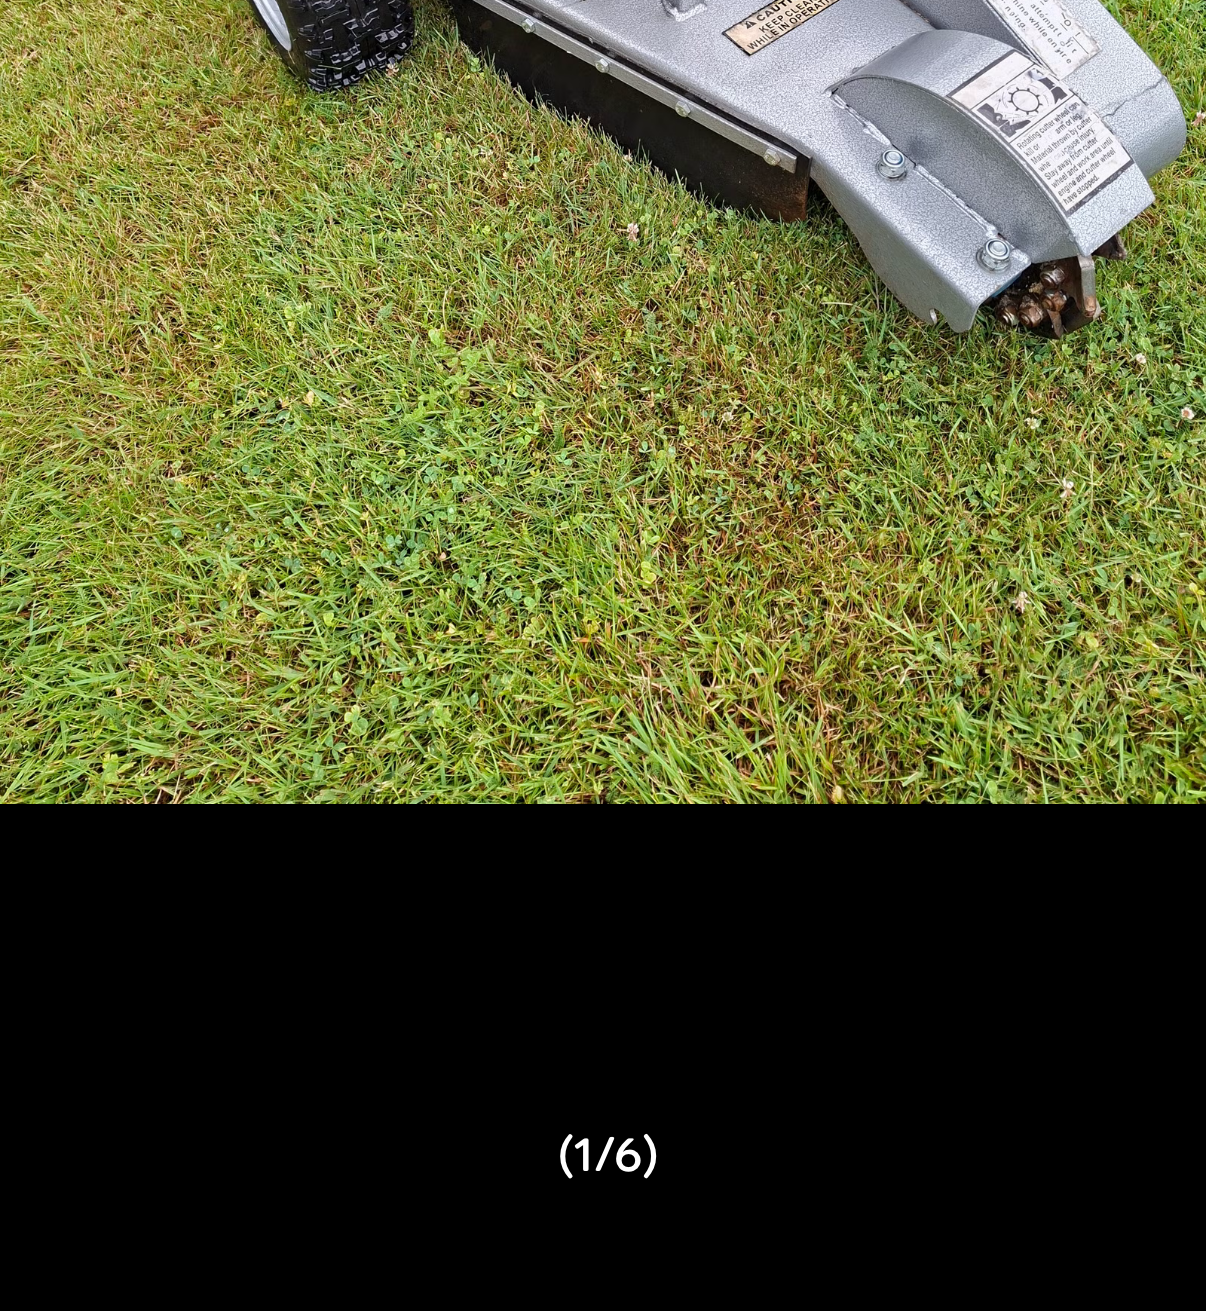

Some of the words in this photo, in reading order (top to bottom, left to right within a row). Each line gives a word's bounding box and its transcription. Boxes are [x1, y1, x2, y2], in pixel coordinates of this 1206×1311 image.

[747, 29, 780, 50] WHILE
[778, 22, 790, 33] IN
[759, 15, 784, 33] KEEP
[1029, 16, 1048, 38] while
[1016, 130, 1042, 150] Rotating
[1039, 119, 1055, 136] cutter
[1055, 109, 1070, 123] wheel
[1030, 146, 1054, 165] Material
[1051, 132, 1072, 150] thrown
[1069, 125, 1080, 136] by
[1076, 116, 1093, 130] cutter
[1054, 124, 1067, 135] arm
[1065, 118, 1073, 127] or
[1044, 167, 1060, 180] Stay
[1057, 157, 1074, 172] away
[1070, 146, 1085, 161] from
[1082, 137, 1099, 152] cutter
[1051, 174, 1070, 189] wheel
[1066, 165, 1080, 177] and
[1076, 155, 1092, 169] work
[1088, 147, 1103, 160] area
[1100, 137, 1114, 151] until
[1057, 179, 1077, 197] engine
[1075, 172, 1088, 184] and
[1085, 160, 1101, 175] cutter
[1099, 147, 1116, 163] wheel
[1062, 191, 1078, 205] have
[1076, 175, 1100, 195] stopped.
